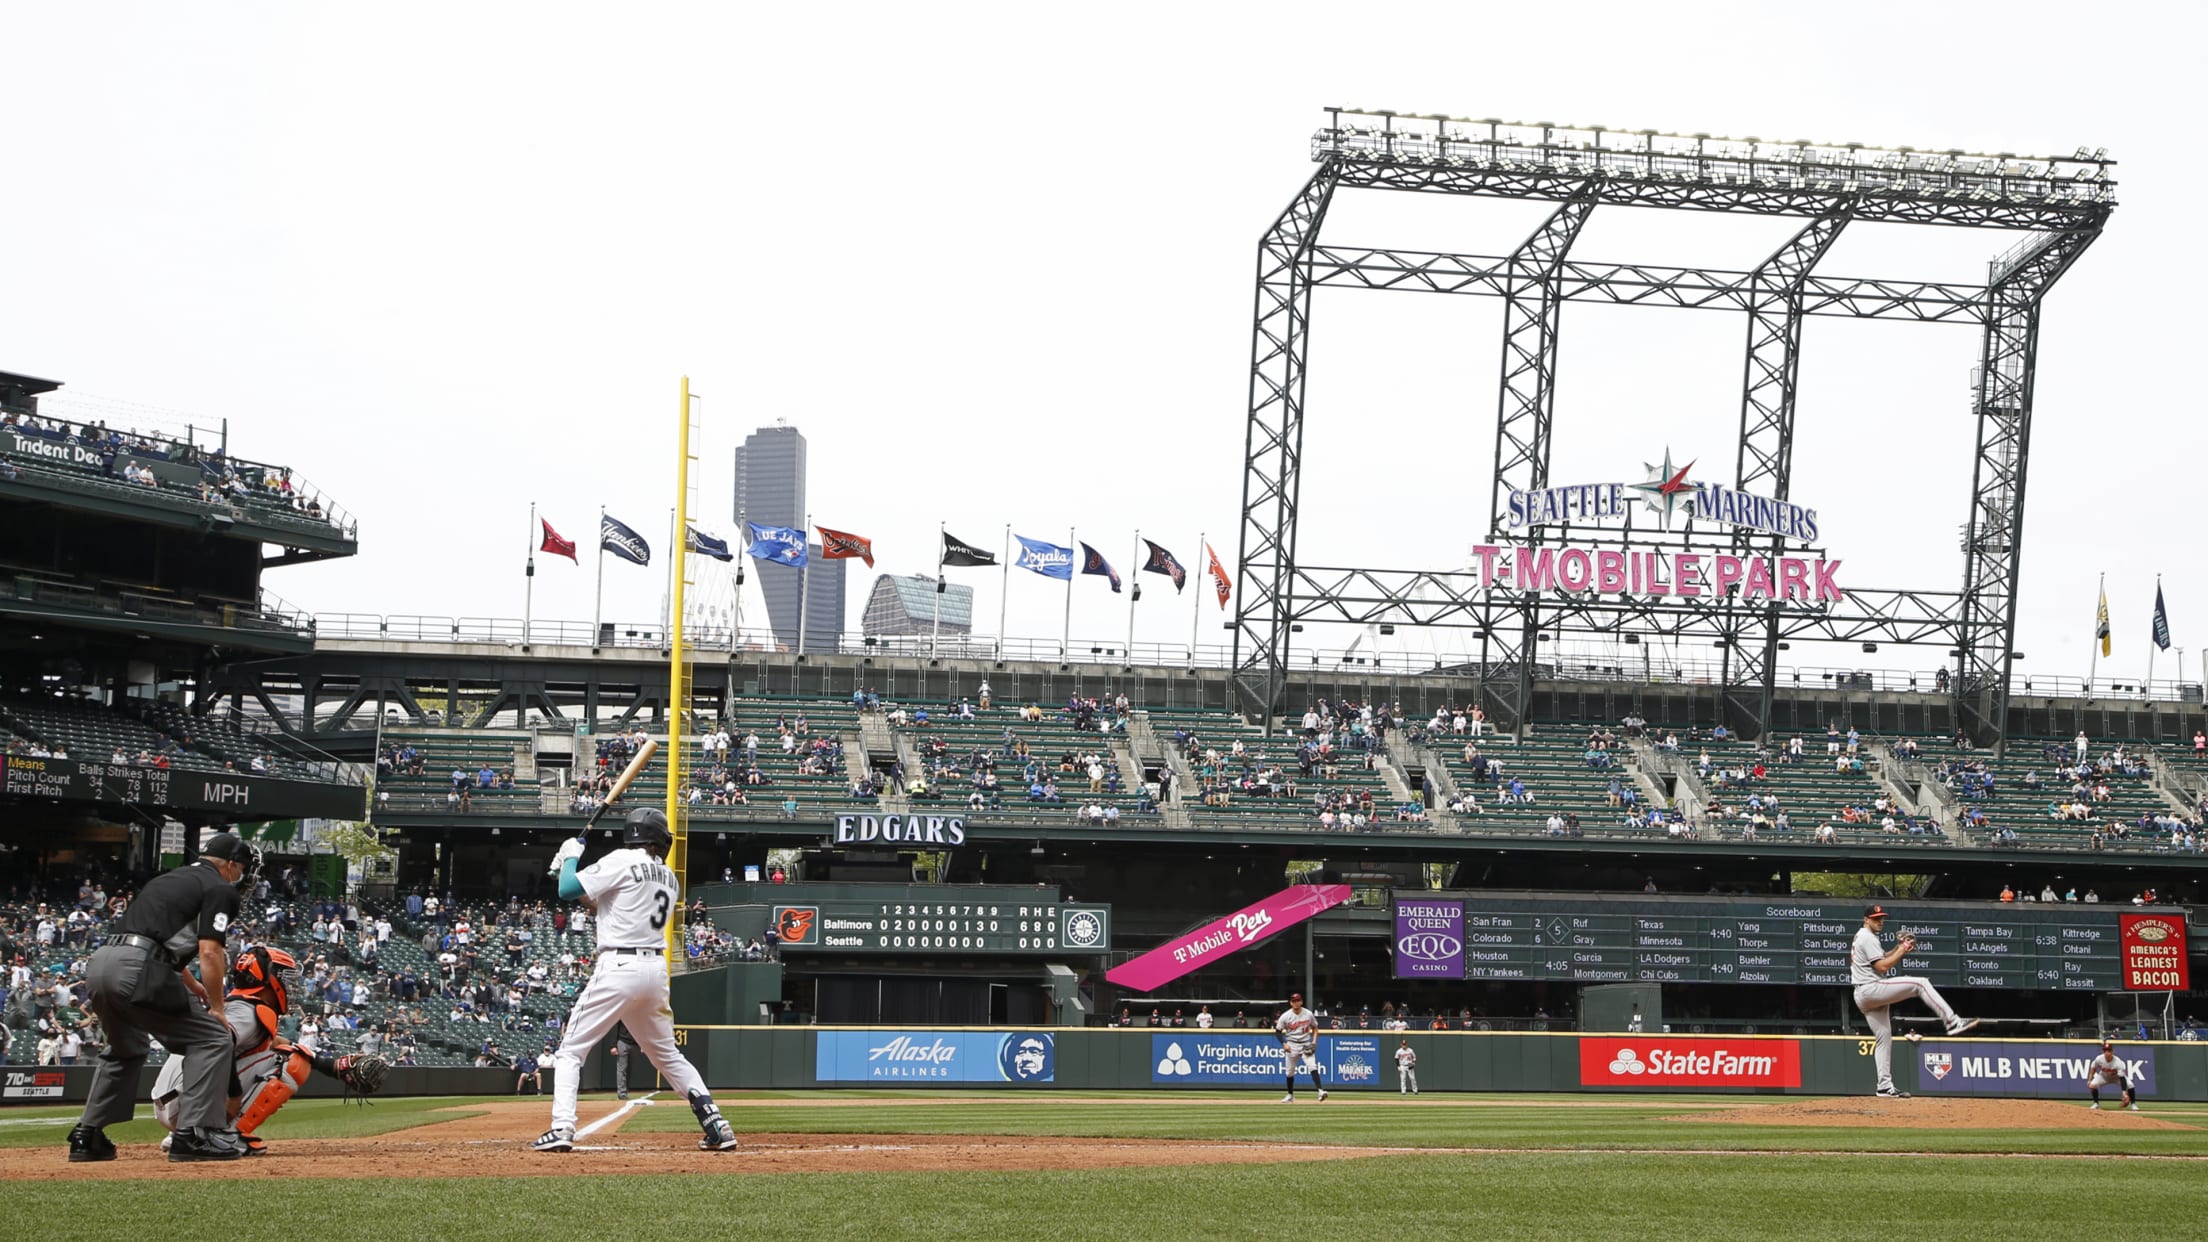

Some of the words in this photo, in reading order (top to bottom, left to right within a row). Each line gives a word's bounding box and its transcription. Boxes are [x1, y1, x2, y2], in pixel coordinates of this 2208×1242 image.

[13, 435, 69, 459] Trident
[1507, 482, 1626, 529] SEATTLE
[1694, 481, 1819, 543] MARINERS
[779, 532, 804, 550] JAYS
[1472, 544, 1702, 598] T-MOBILE
[1712, 554, 1844, 601] PARK
[7, 757, 46, 771] Means
[79, 763, 104, 776] Balls
[107, 765, 143, 779] Strikes
[145, 769, 170, 781] Total
[7, 769, 35, 782] Pitch
[39, 772, 71, 785] Count
[89, 776, 103, 787] 34
[127, 779, 141, 791] 78
[150, 782, 168, 793] 112
[6, 781, 31, 794] First
[35, 783, 62, 797] Pitch
[95, 788, 102, 800] 2
[126, 791, 140, 802] 24
[153, 793, 167, 805] 26
[204, 782, 249, 805] MPH
[837, 814, 965, 845] EDGAR'S
[649, 889, 670, 930] 3
[881, 905, 888, 914] 1
[895, 905, 902, 914] 2
[908, 905, 916, 915] 3
[922, 906, 929, 915] 4
[936, 906, 944, 915] 5
[949, 906, 957, 915] 6
[963, 906, 970, 915] 7
[977, 906, 984, 915] 8
[990, 907, 998, 915] 9
[1019, 907, 1028, 917] R
[1033, 907, 1042, 917] H
[1047, 907, 1055, 917] E
[1398, 906, 1461, 918] EMERALD
[1766, 907, 1821, 917] Scoreboard
[213, 912, 228, 932] 9
[824, 919, 873, 931] Baltimore
[880, 919, 888, 930] 0
[894, 920, 902, 930] 2
[907, 920, 915, 930] 0
[921, 920, 929, 931] 0
[935, 920, 943, 931] 0
[949, 921, 957, 931] 0
[964, 921, 970, 932] 1
[976, 921, 984, 932] 3
[990, 921, 998, 932] 0
[1019, 921, 1028, 932] 6
[1047, 922, 1055, 932] 0
[1408, 918, 1452, 931] QUEEN
[1472, 917, 1489, 926] San
[1492, 917, 1512, 926] Fran
[1534, 918, 1541, 928] 2
[1573, 918, 1588, 928] Ruf
[1638, 920, 1664, 929] Texas
[1738, 922, 1760, 933] Yang
[1554, 926, 1561, 935] 5
[1710, 929, 1732, 938] 4:40
[1803, 923, 1845, 935] Pittsburgh
[1965, 926, 1993, 937] Tampa
[1996, 927, 2013, 938] Bay
[2062, 928, 2101, 940] Kittredge
[825, 936, 863, 946] Seattle
[880, 936, 888, 947] 0
[893, 936, 901, 947] 0
[907, 936, 915, 947] 0
[921, 936, 929, 947] 0
[935, 936, 943, 948] 0
[949, 937, 957, 948] 0
[962, 937, 970, 948] 0
[976, 937, 984, 948] 0
[1019, 937, 1027, 948] 0
[1033, 938, 1041, 948] 0
[1047, 938, 1055, 948] 0
[1472, 933, 1512, 943] Colorado
[1534, 934, 1541, 943] 6
[1573, 935, 1595, 945] Gray
[1639, 936, 1683, 946] Minnesota
[1880, 932, 1895, 941] :10
[2035, 936, 2057, 945] 6:38
[1186, 930, 1233, 959] Mobile
[1407, 935, 1457, 960] EQC
[1738, 938, 1768, 949] Thorpe
[1804, 939, 1820, 948] San
[1823, 939, 1848, 950] Diego
[1915, 941, 1933, 951] vish
[1966, 943, 1978, 952] LA
[1980, 943, 2008, 953] Angels
[2063, 944, 2091, 954] Ohtani
[2130, 945, 2178, 955] AMERICA'S
[1472, 951, 1508, 961] Houston
[1573, 952, 1603, 962] Garcia
[1640, 953, 1652, 963] LA
[1654, 953, 1690, 965] Dodgers
[1739, 955, 1771, 965] Buehler
[1804, 957, 1846, 966] Cleveland
[1545, 961, 1568, 971] 4:05
[1711, 963, 1733, 973] 4:40
[1902, 958, 1930, 968] Bieber
[1967, 960, 1999, 969] Toronto
[2064, 962, 2081, 973] Ray
[2130, 957, 2178, 969] LEANEST
[1473, 967, 1486, 977] NY
[1488, 967, 1523, 977] Yankees
[1574, 969, 1628, 979] Montgomery
[1640, 970, 1655, 979] Chi
[1656, 970, 1679, 979] Cubs
[1739, 971, 1770, 981] Alzolay
[1805, 973, 1836, 982] Kansas
[1838, 973, 1852, 982] Cit
[1885, 967, 1896, 977] 10
[2037, 970, 2059, 980] 6:40
[1968, 975, 2003, 985] Oakland
[2065, 977, 2094, 987] Bassitt
[2132, 970, 2180, 986] BACON
[673, 1030, 688, 1046] 31
[869, 1036, 956, 1064] Alaska
[1197, 1044, 1252, 1060] Virginia
[1255, 1045, 1285, 1058] Mas
[1858, 1040, 1876, 1056] 37
[1198, 1060, 1276, 1075] Franciscan
[1648, 1049, 1710, 1075] State
[1711, 1050, 1771, 1076] Farm
[874, 1067, 948, 1076] AIRLINES
[1961, 1057, 2012, 1078] MLB
[2019, 1058, 2146, 1081] NETWK
[5, 1072, 25, 1086] 710
[34, 1072, 65, 1086] ESPN
[22, 1088, 49, 1096] SEATTLE
